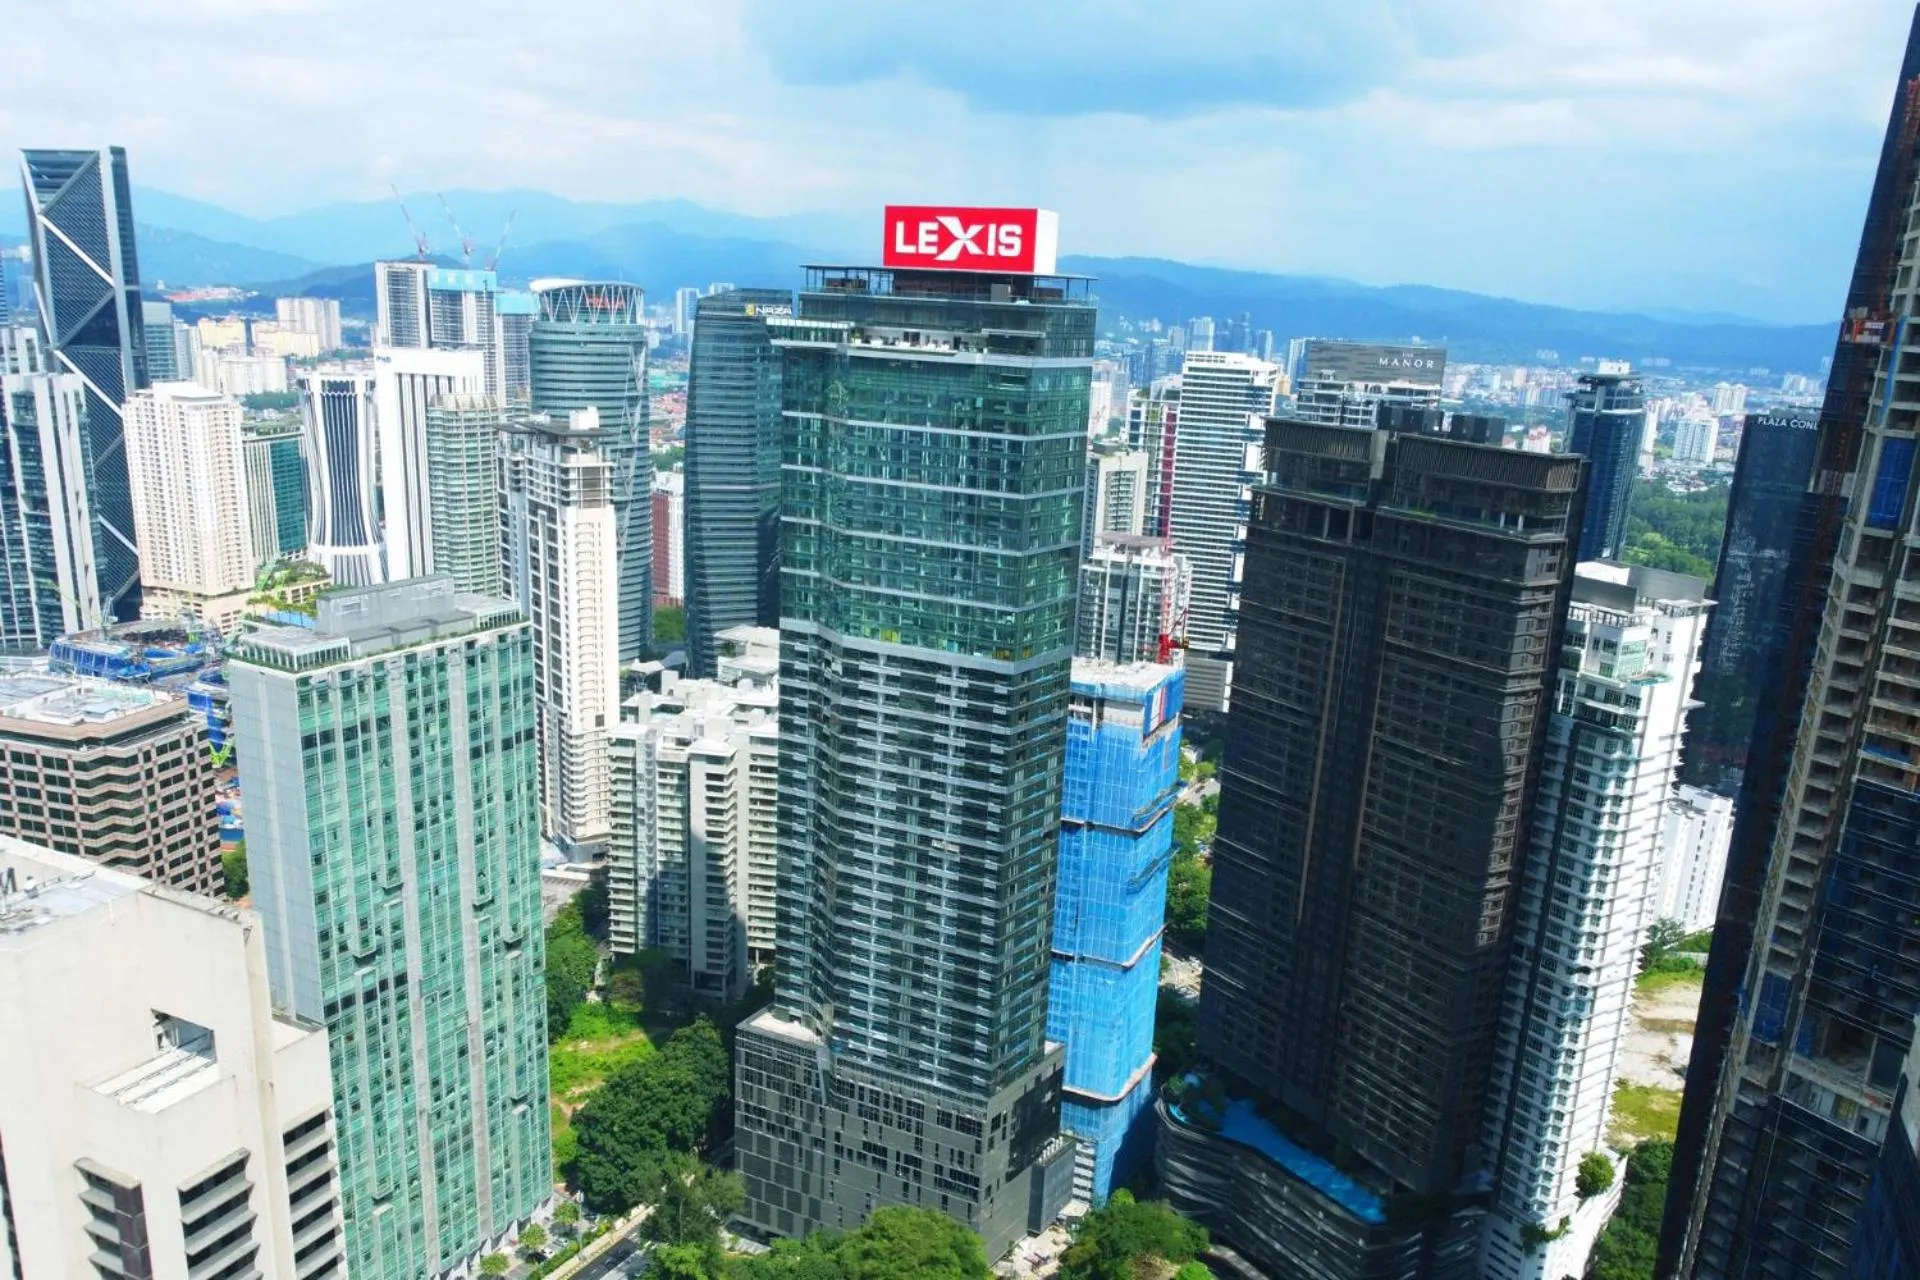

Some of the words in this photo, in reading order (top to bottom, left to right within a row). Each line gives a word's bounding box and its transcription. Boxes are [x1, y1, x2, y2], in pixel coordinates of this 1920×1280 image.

[895, 215, 1023, 262] LEXIS
[1379, 356, 1435, 369] MANOR
[1757, 416, 1787, 427] PLAZA
[1790, 419, 1819, 430] CONL
